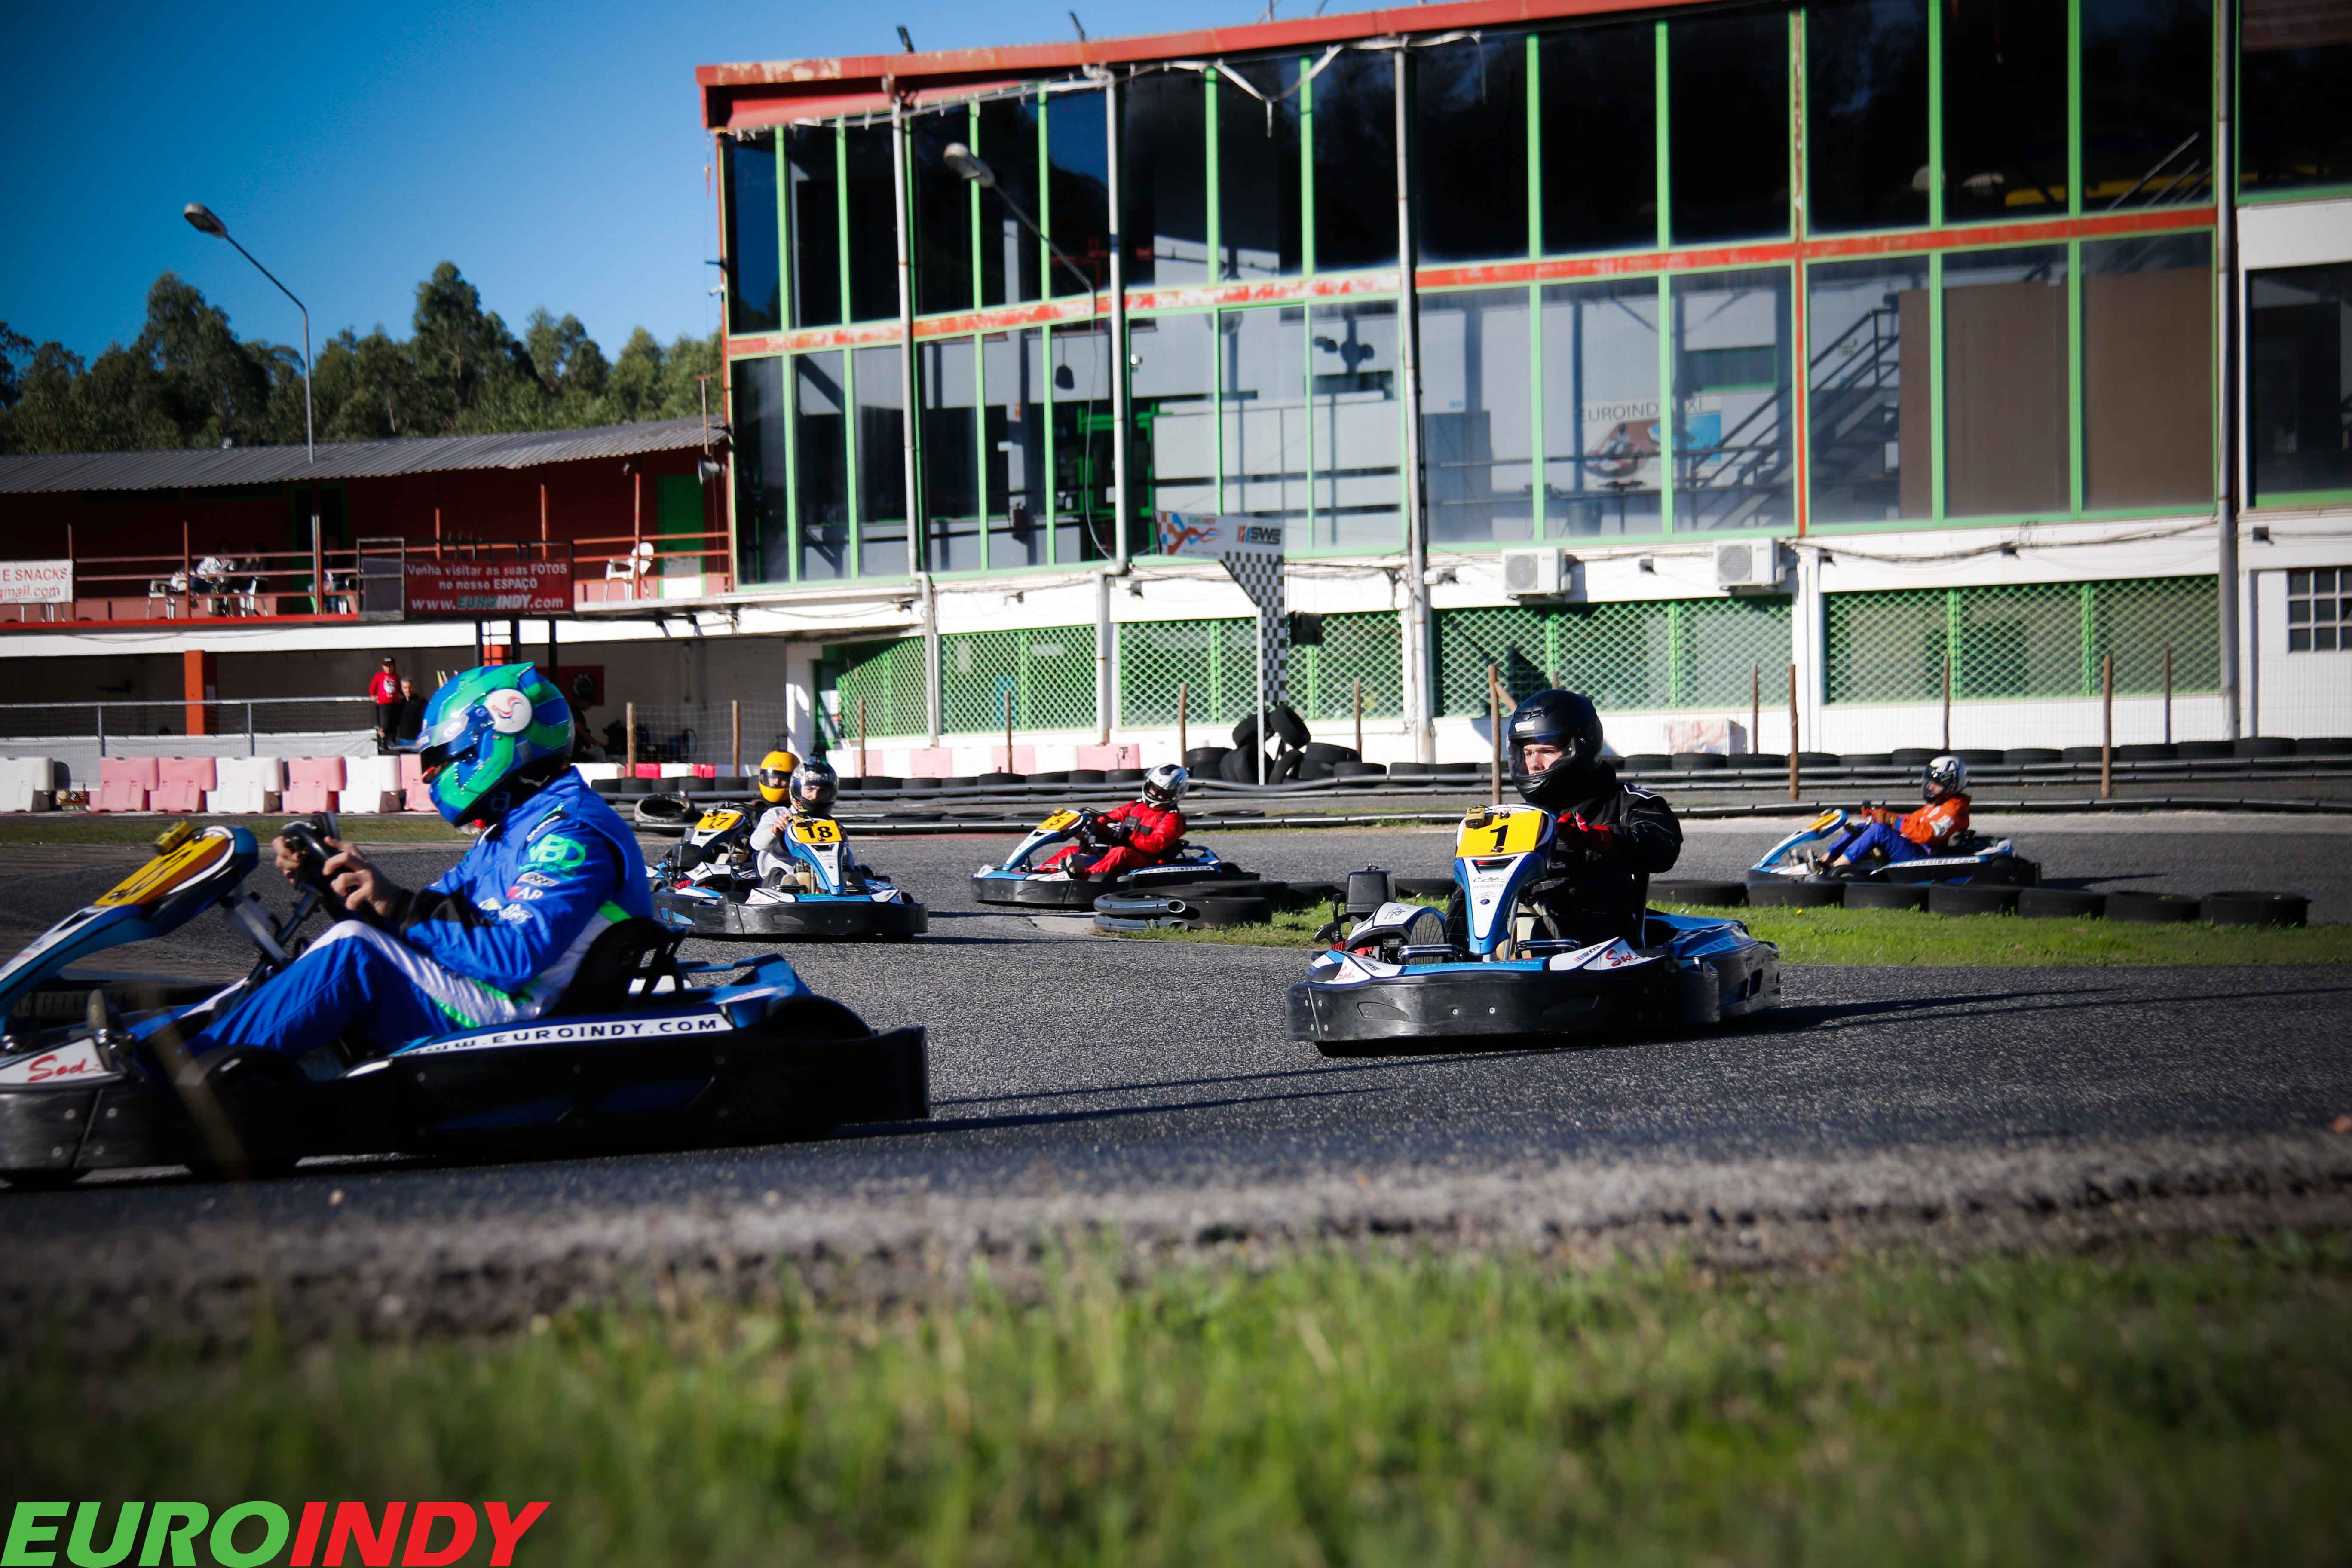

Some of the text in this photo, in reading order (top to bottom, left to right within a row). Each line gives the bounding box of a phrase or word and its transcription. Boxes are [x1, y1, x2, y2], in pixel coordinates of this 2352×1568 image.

[3, 567, 68, 581] E SNACKS
[407, 563, 568, 576] Venha visitar as suas FOTOS
[439, 577, 537, 591] no nosso ESPAÇO
[411, 595, 564, 610] www.EUROINDY.com
[803, 825, 833, 839] 18
[1490, 825, 1509, 847] 1
